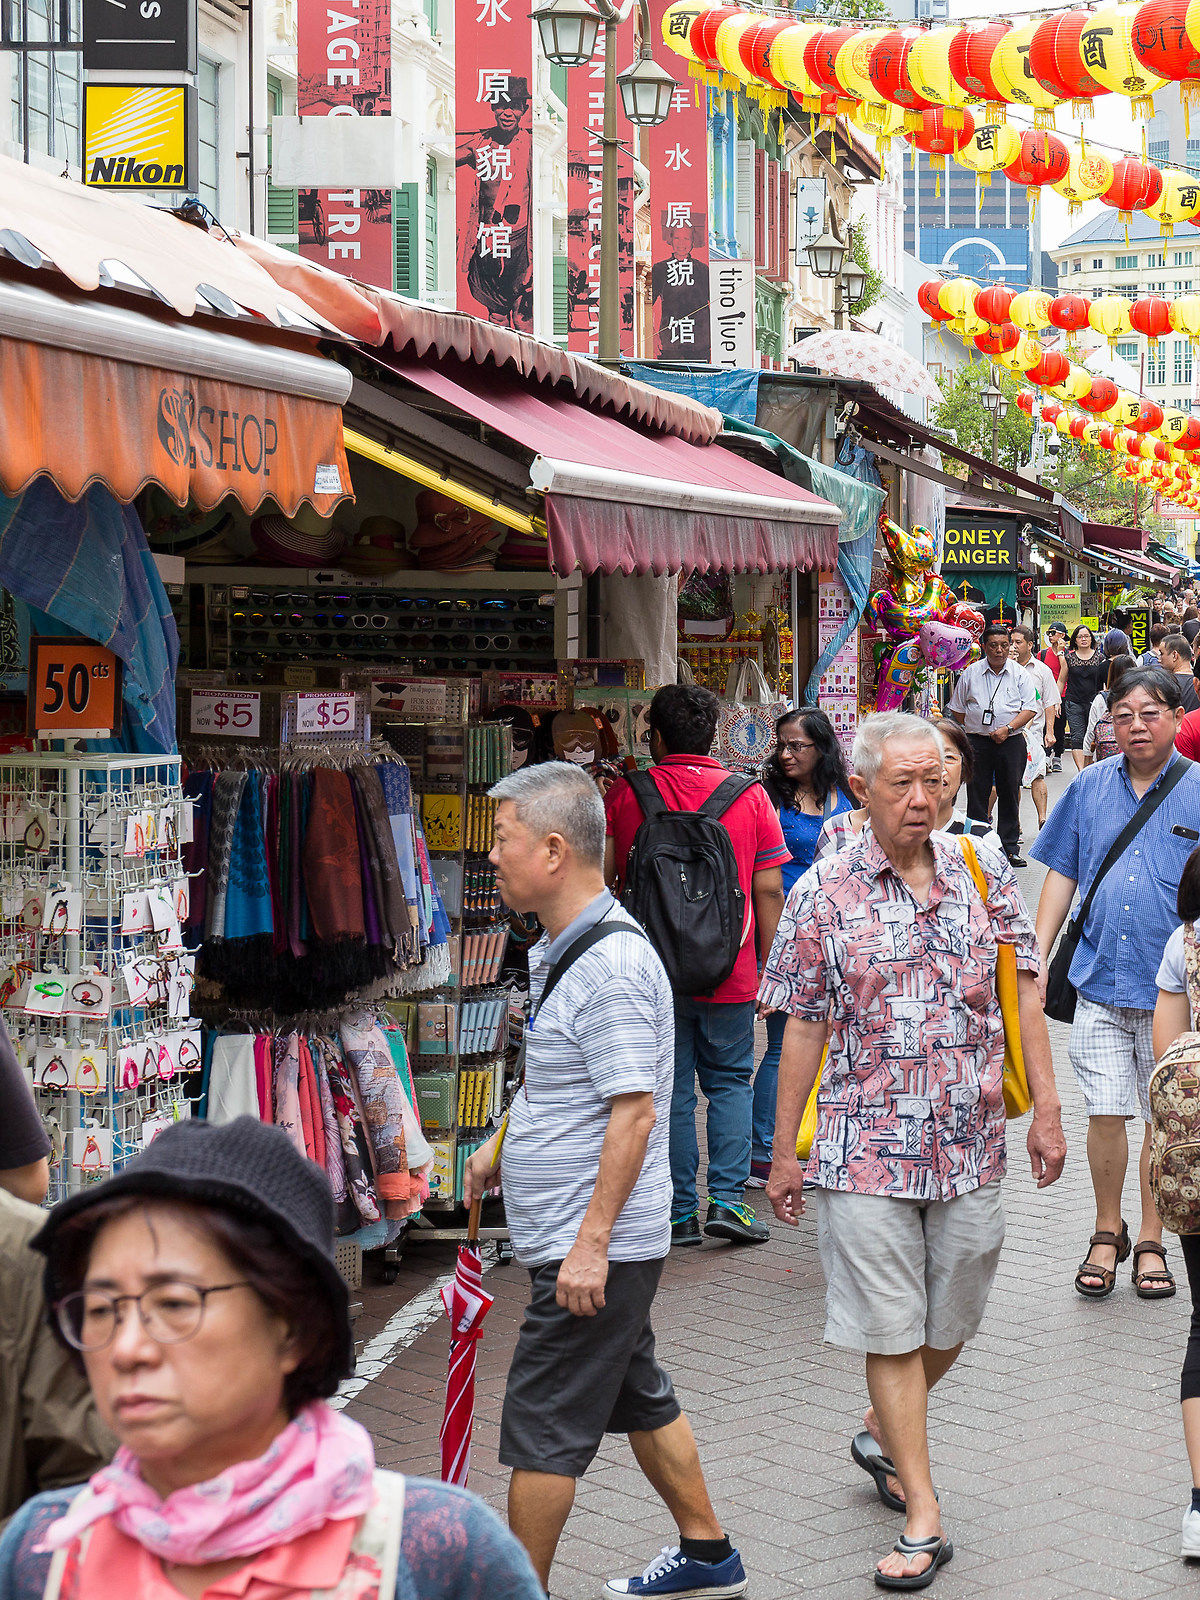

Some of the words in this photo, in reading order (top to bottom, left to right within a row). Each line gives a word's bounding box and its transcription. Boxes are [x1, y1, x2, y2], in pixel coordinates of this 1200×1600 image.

[475, 0, 513, 260] 水原貌馆
[89, 156, 184, 184] Nikon
[663, 42, 696, 346] 车水原貌馆
[719, 267, 743, 308] tino
[197, 404, 278, 476] SHOP
[944, 529, 1006, 545] ONEY
[821, 635, 856, 643] SALE
[1130, 612, 1148, 655] MONEY
[42, 662, 91, 714] 50
[91, 661, 110, 679] cts
[199, 690, 249, 699] PROMOTION
[305, 691, 351, 699] PROMOTION
[196, 717, 211, 726] NOW
[213, 699, 253, 729] $5
[301, 719, 315, 728] NOW
[316, 700, 351, 729] $5
[721, 707, 758, 738] singapore
[759, 711, 778, 754] singapore
